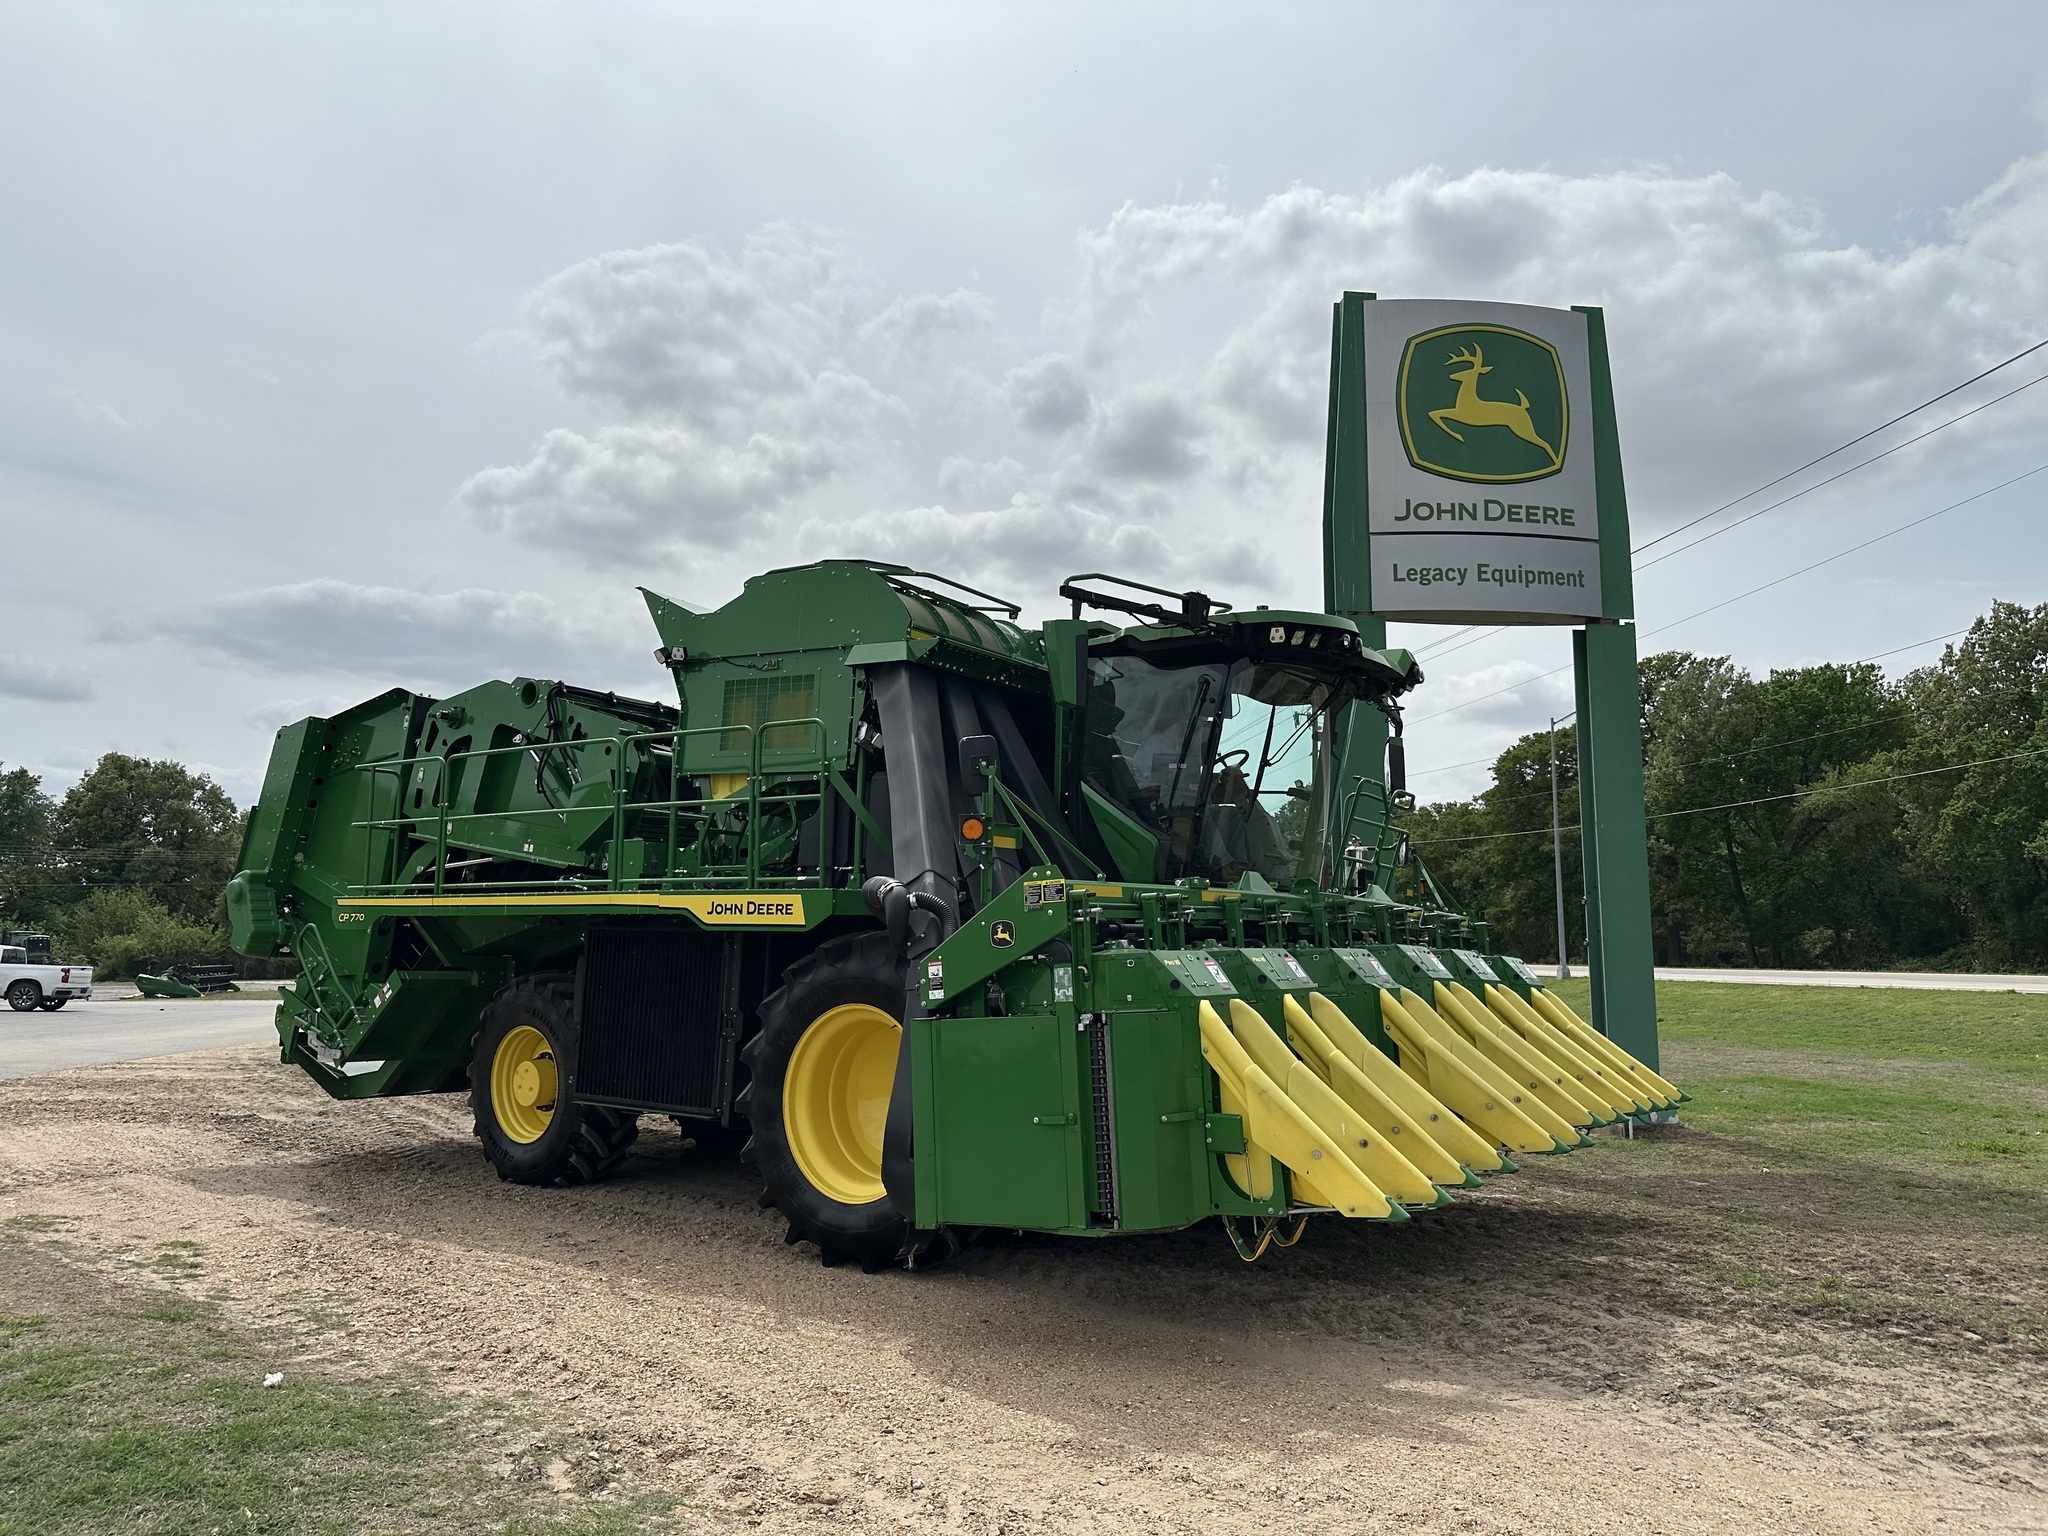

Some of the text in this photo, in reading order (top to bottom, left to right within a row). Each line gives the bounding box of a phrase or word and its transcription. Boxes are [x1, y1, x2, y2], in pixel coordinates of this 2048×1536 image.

[1394, 498, 1576, 527] JOHN DEERE
[1392, 563, 1585, 589] Legacy Equipment
[338, 913, 365, 922] CP 770
[706, 901, 794, 916] JOHN DEERE
[530, 1008, 560, 1044] ALLIANCE
